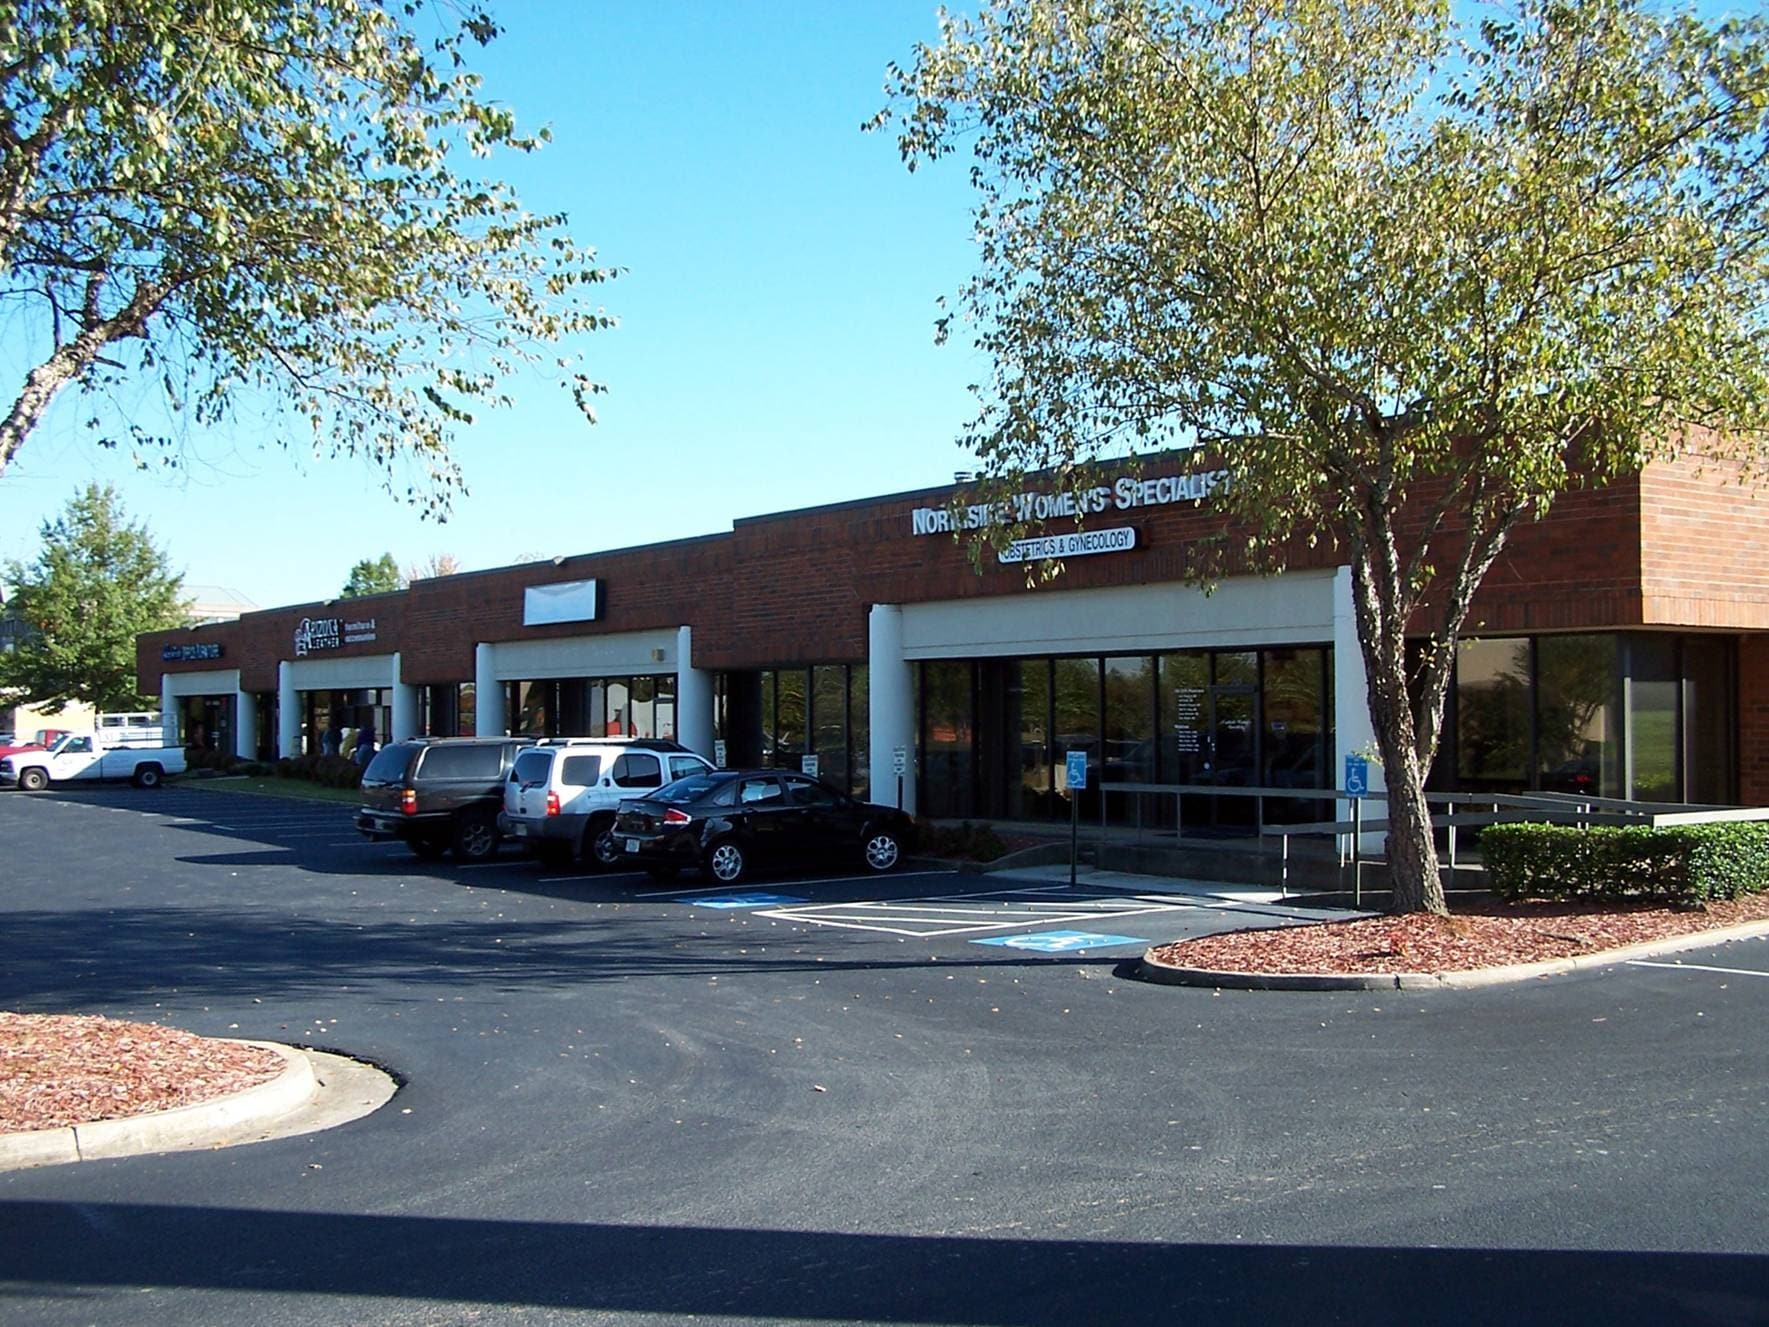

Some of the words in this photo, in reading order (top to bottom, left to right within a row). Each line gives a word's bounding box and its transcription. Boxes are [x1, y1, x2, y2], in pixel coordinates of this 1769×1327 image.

[912, 502, 1013, 535] NORSIE
[1012, 486, 1111, 522] WOMEN'S
[1004, 538, 1056, 561] OBSTETRICS
[1059, 541, 1065, 553] &
[1069, 530, 1131, 553] GYNECOLOGY
